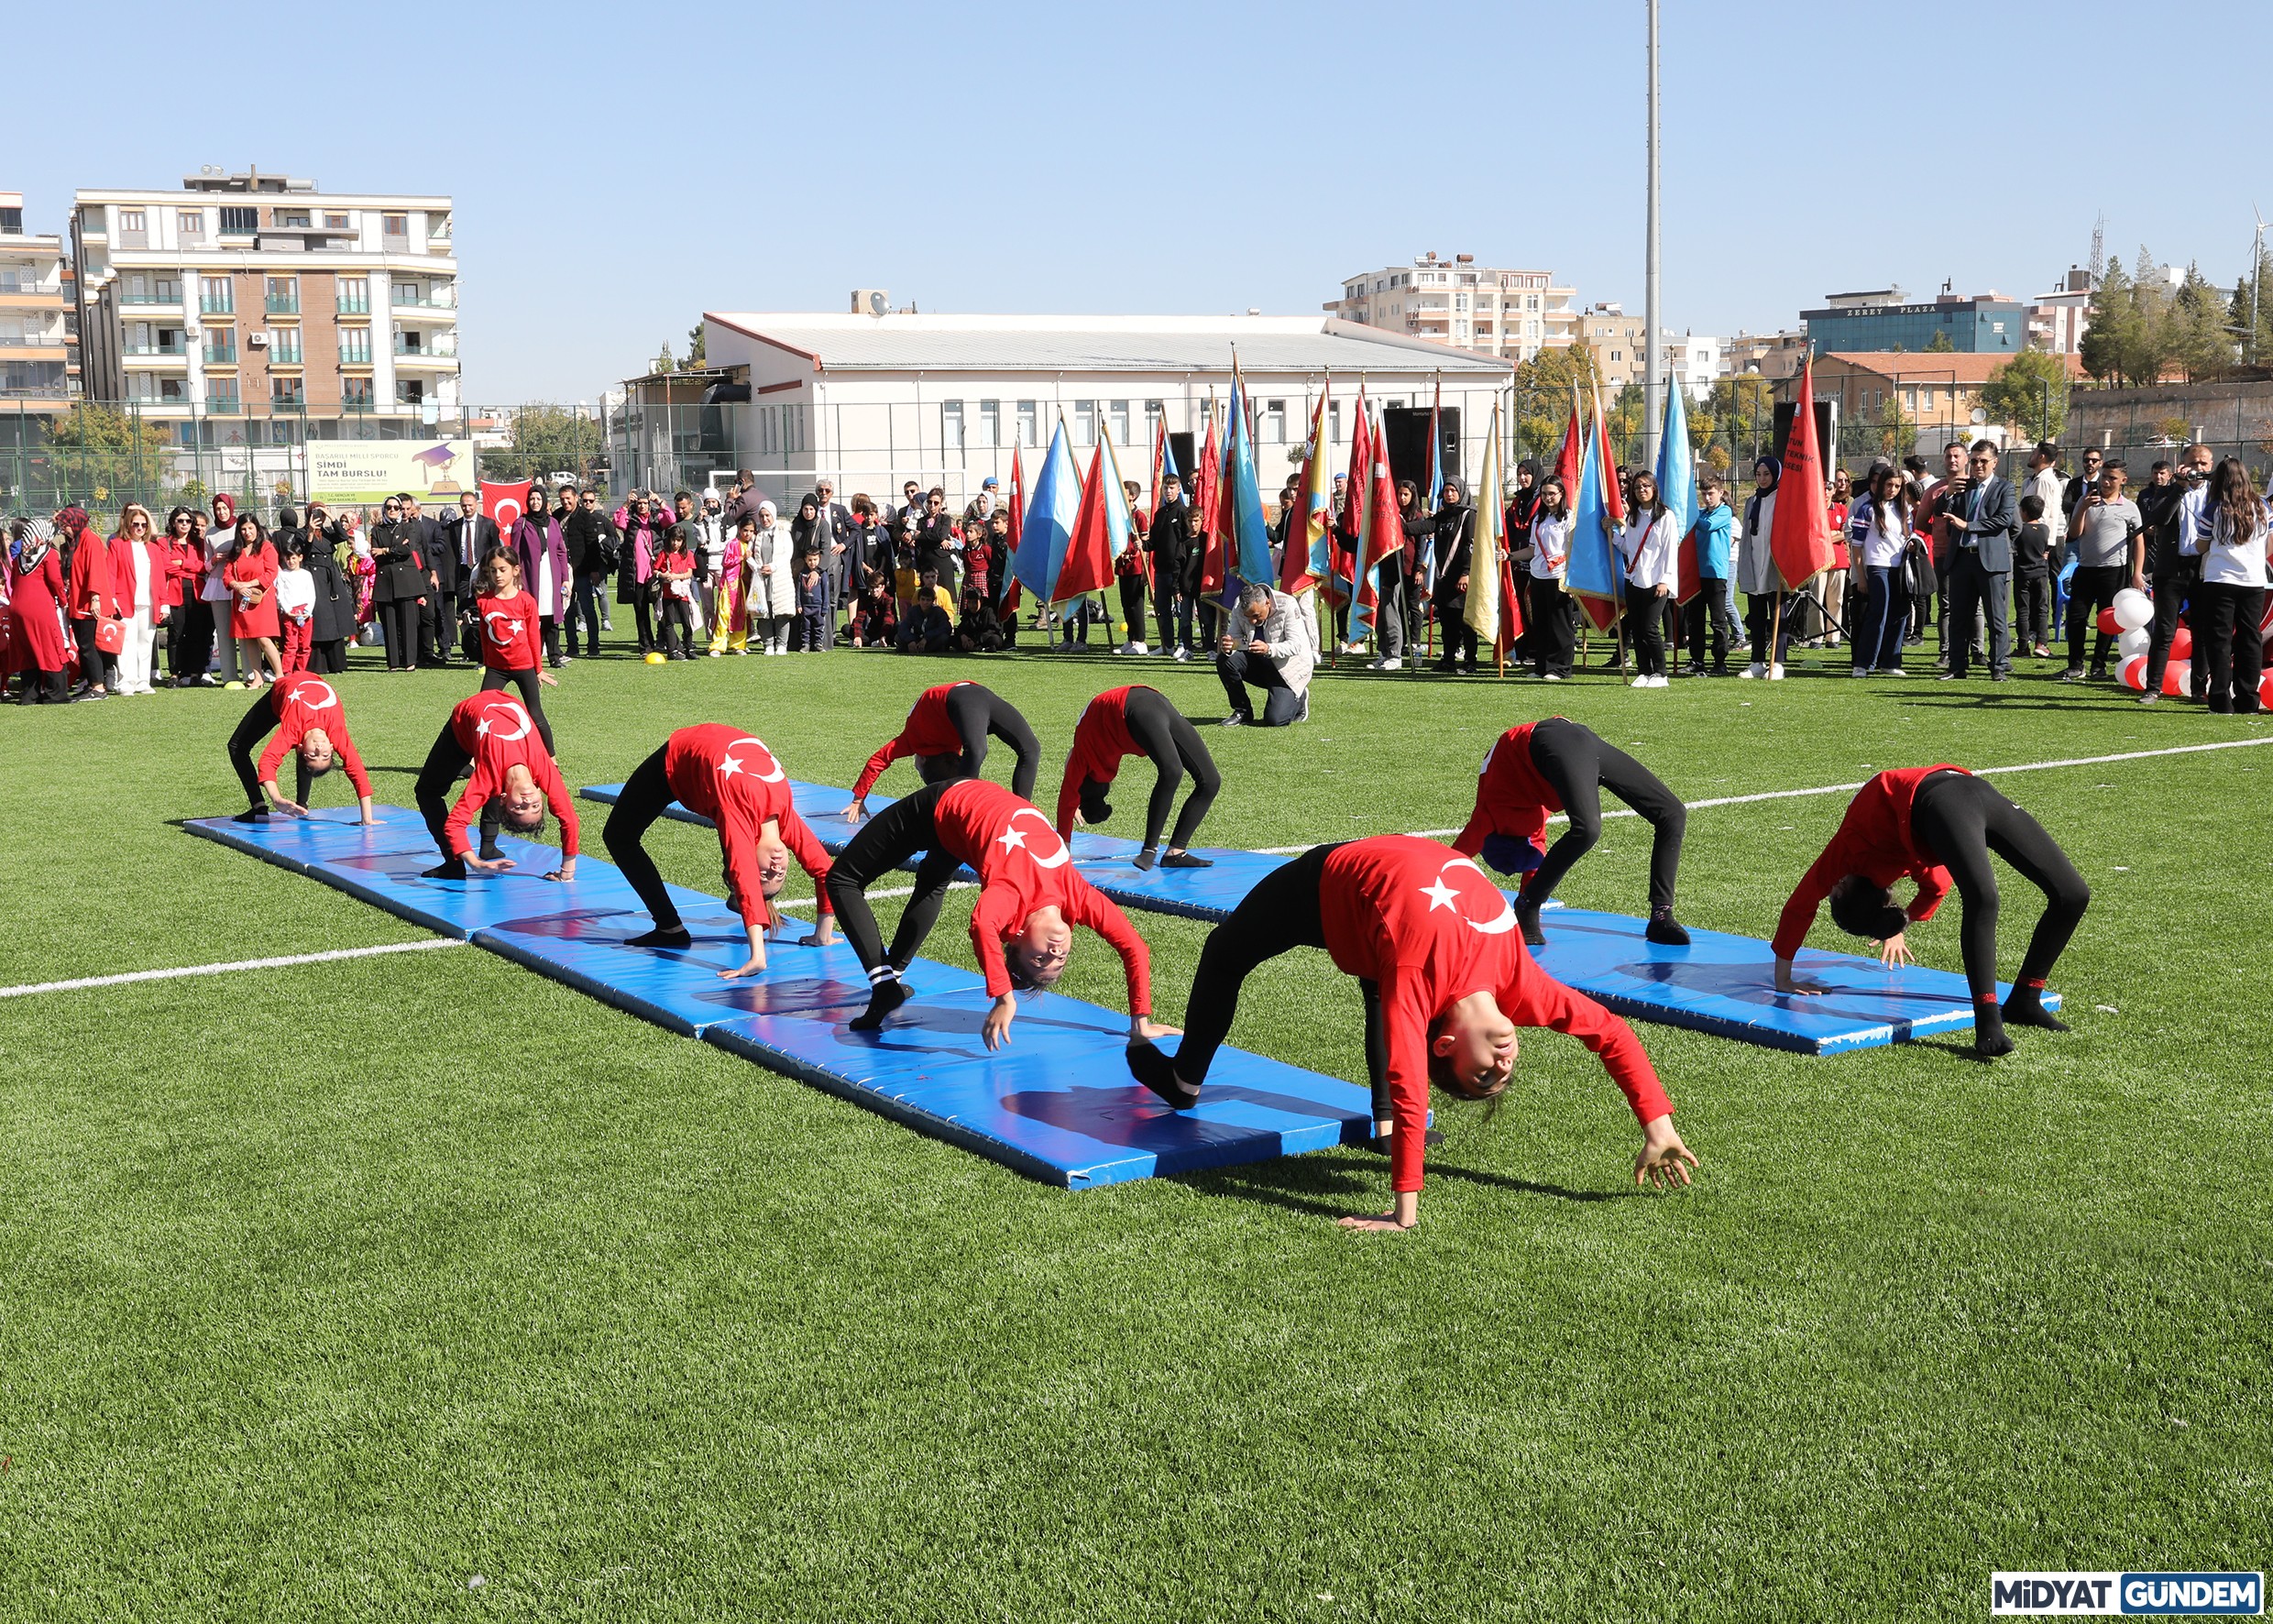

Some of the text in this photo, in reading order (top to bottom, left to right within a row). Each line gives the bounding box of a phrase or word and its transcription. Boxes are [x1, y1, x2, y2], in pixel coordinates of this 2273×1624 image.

[1847, 305, 1937, 317] ZEREY PLAZA
[1788, 438, 1803, 447] TUN
[316, 460, 346, 469] ŞİMDİ
